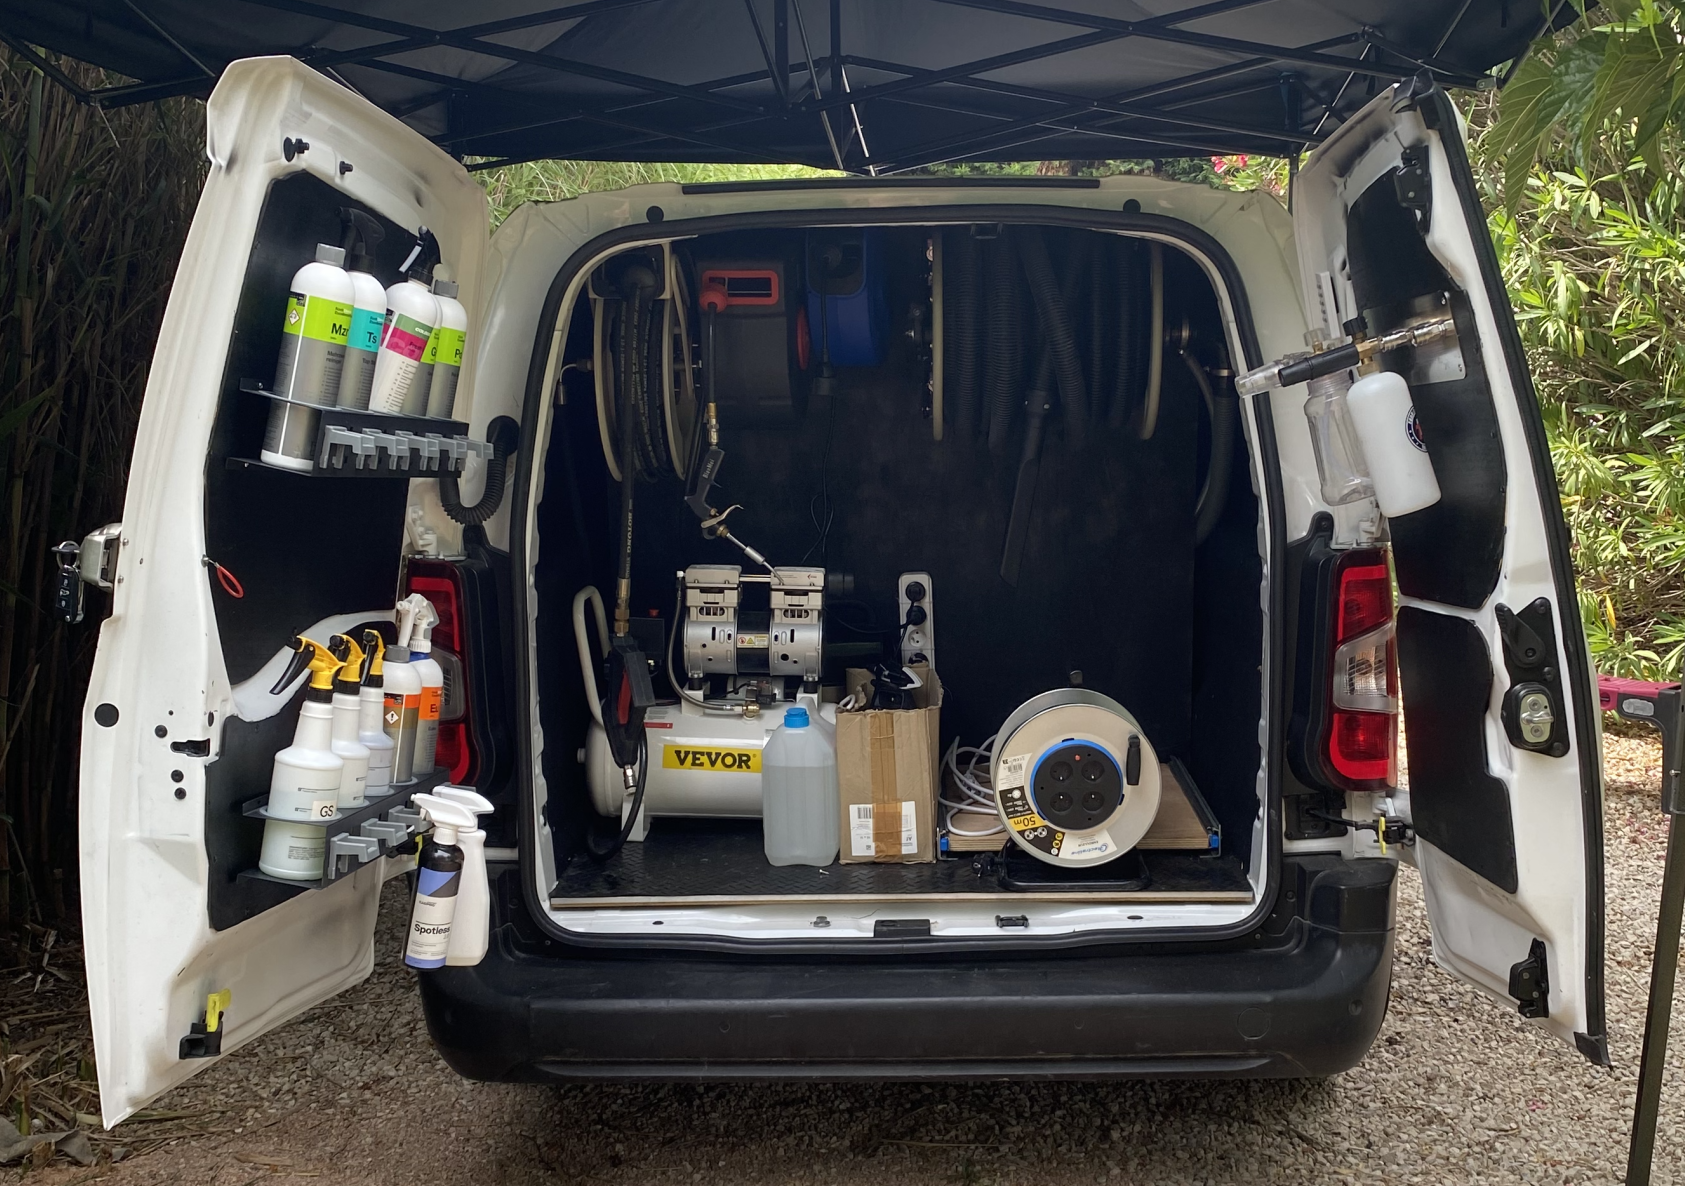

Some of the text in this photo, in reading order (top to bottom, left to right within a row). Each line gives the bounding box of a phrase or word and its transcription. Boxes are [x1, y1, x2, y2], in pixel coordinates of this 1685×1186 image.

[367, 331, 378, 344] Ts
[674, 749, 751, 770] VEVOR
[319, 804, 334, 818] GS
[414, 923, 451, 935] Spotless
